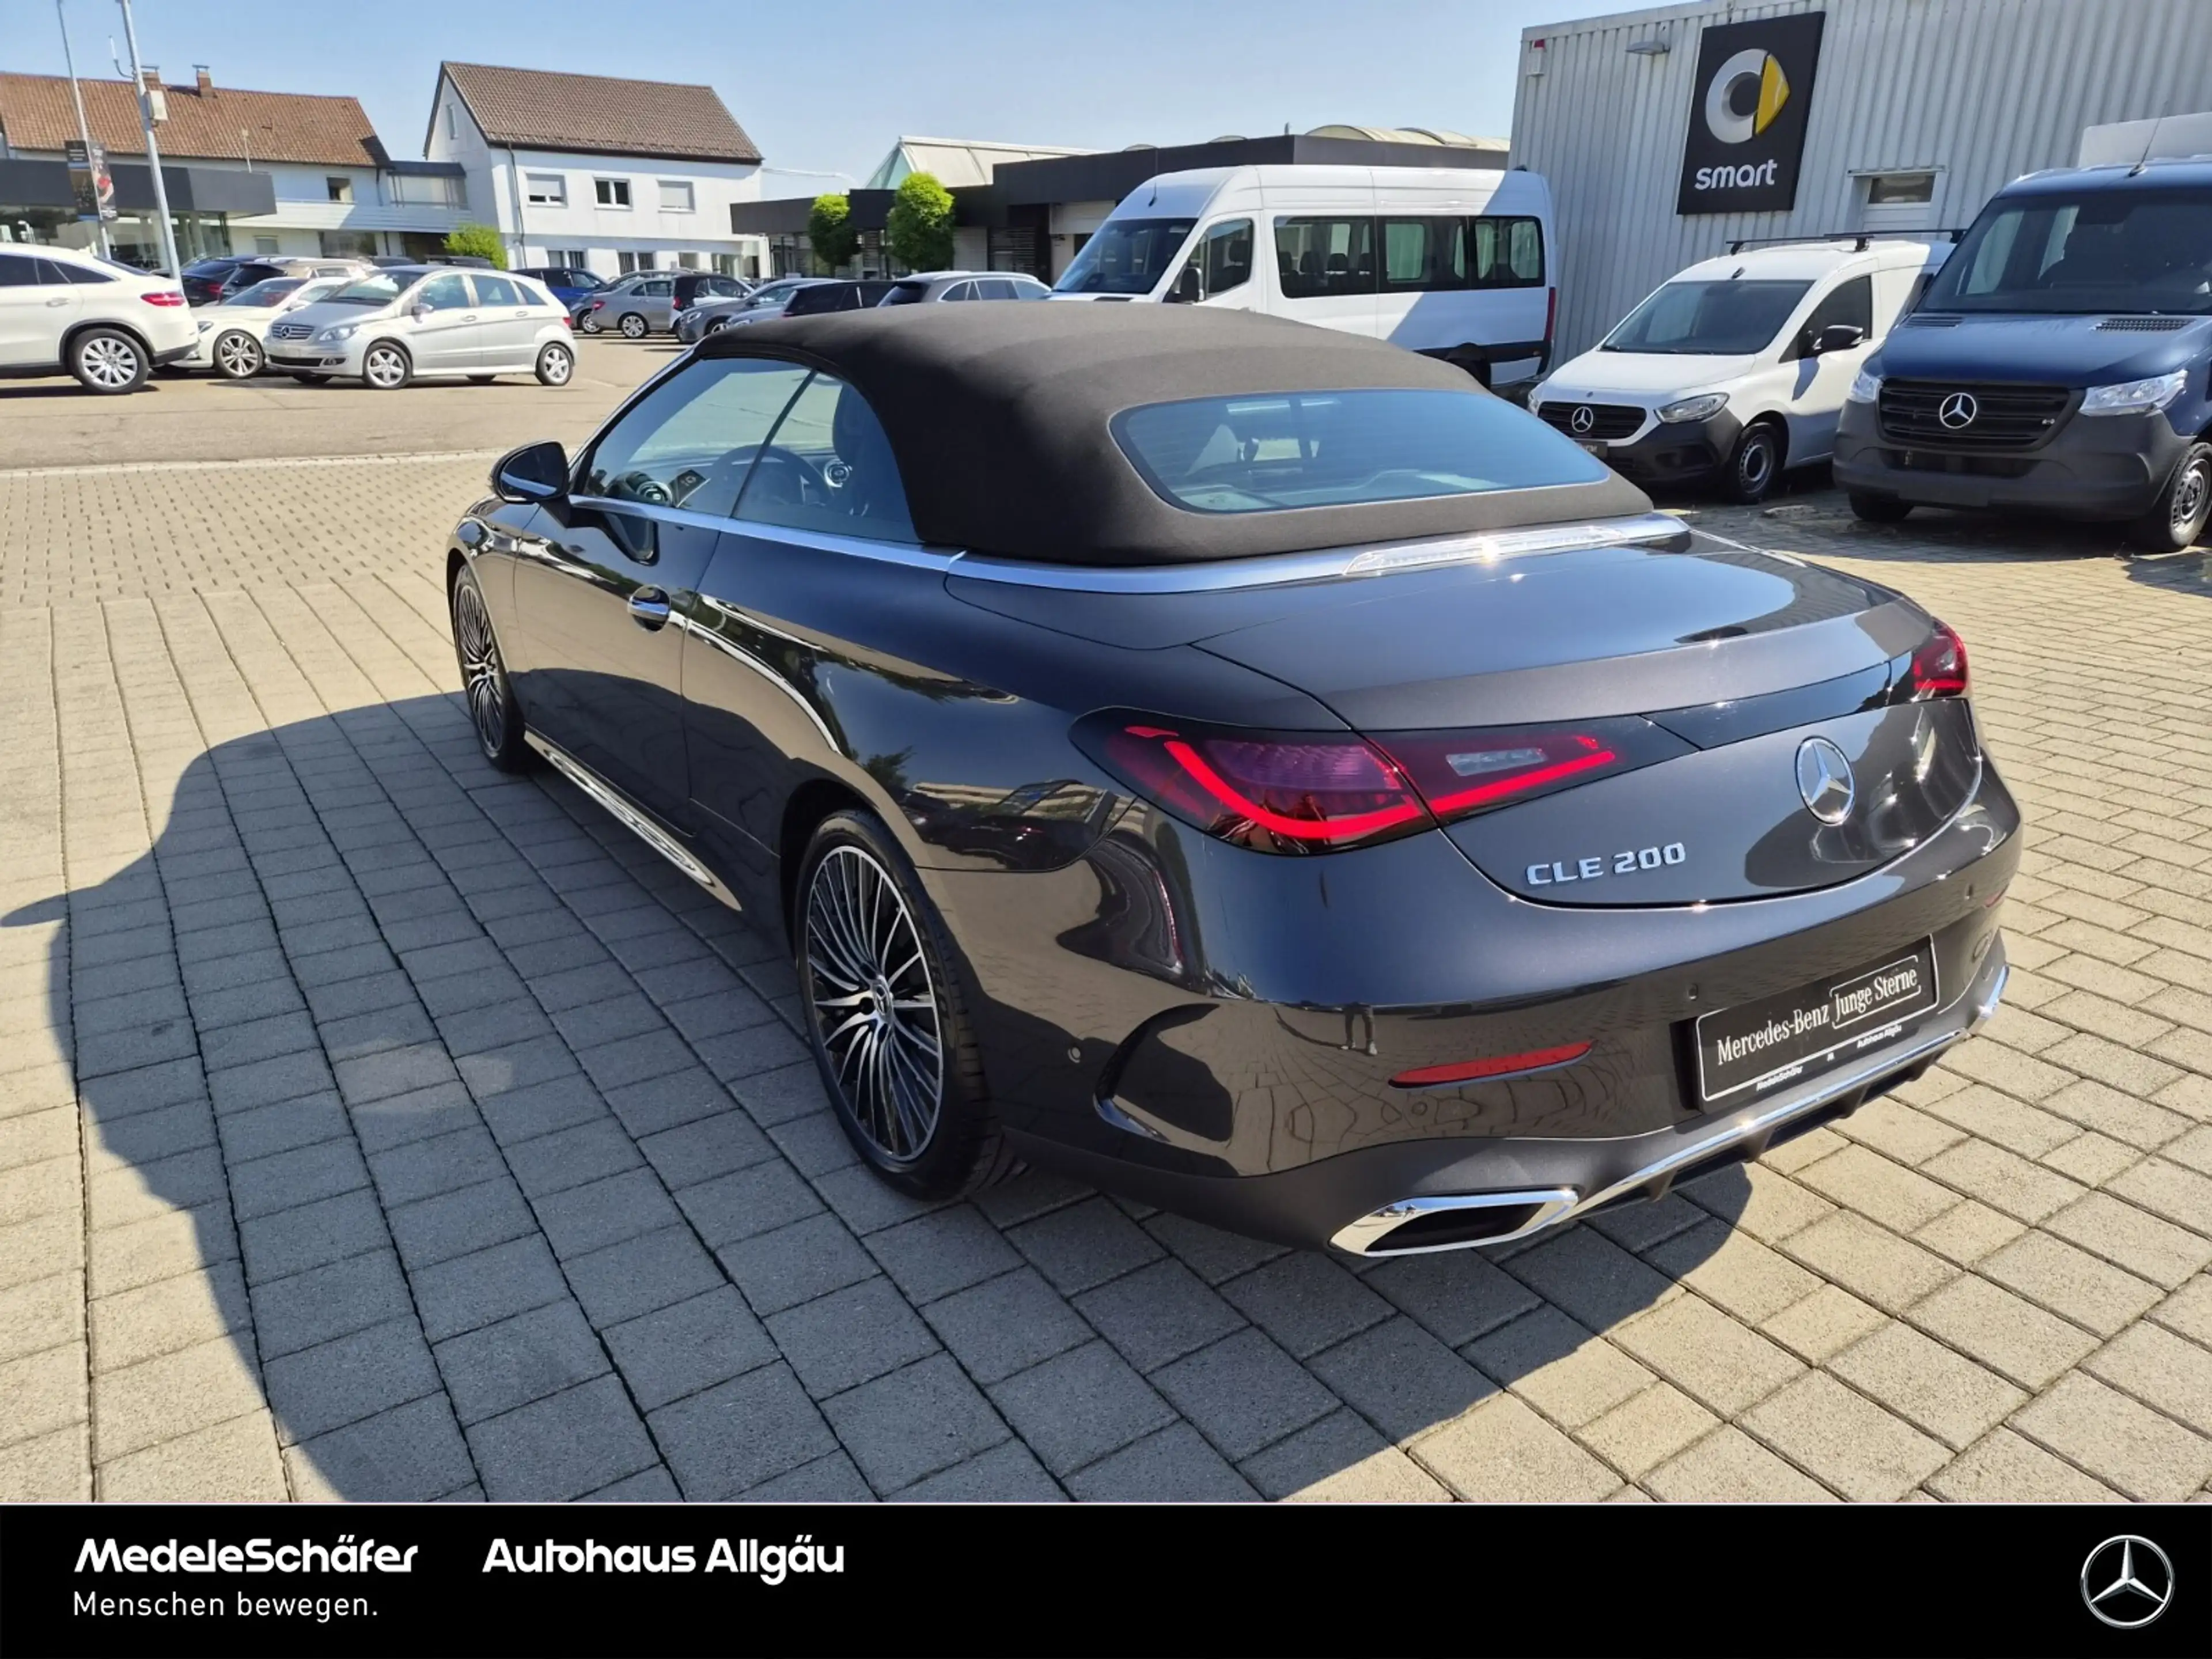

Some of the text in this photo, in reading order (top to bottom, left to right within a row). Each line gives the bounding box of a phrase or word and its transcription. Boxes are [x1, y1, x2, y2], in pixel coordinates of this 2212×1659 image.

[1694, 158, 1778, 191] smart
[1526, 842, 1686, 885] CLE 200
[1716, 968, 1918, 1065] Mercedes-Benz Junge Sterne
